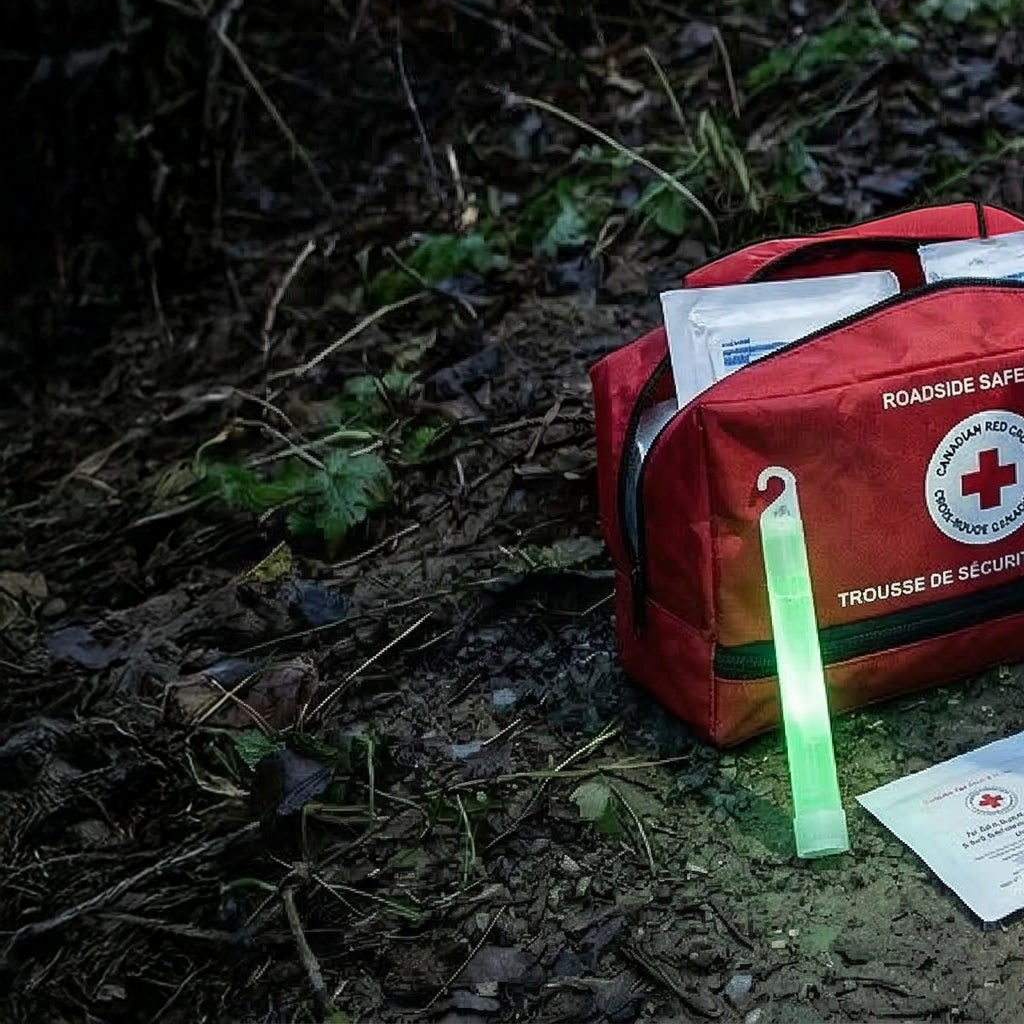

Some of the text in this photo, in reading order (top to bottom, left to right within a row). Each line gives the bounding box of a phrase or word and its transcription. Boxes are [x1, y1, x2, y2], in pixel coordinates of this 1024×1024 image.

[883, 377, 975, 410] ROADSIDE
[936, 423, 981, 476] CANADIAN
[985, 421, 1008, 432] RED
[837, 576, 925, 608] TROUSSE
[930, 569, 954, 588] DE
